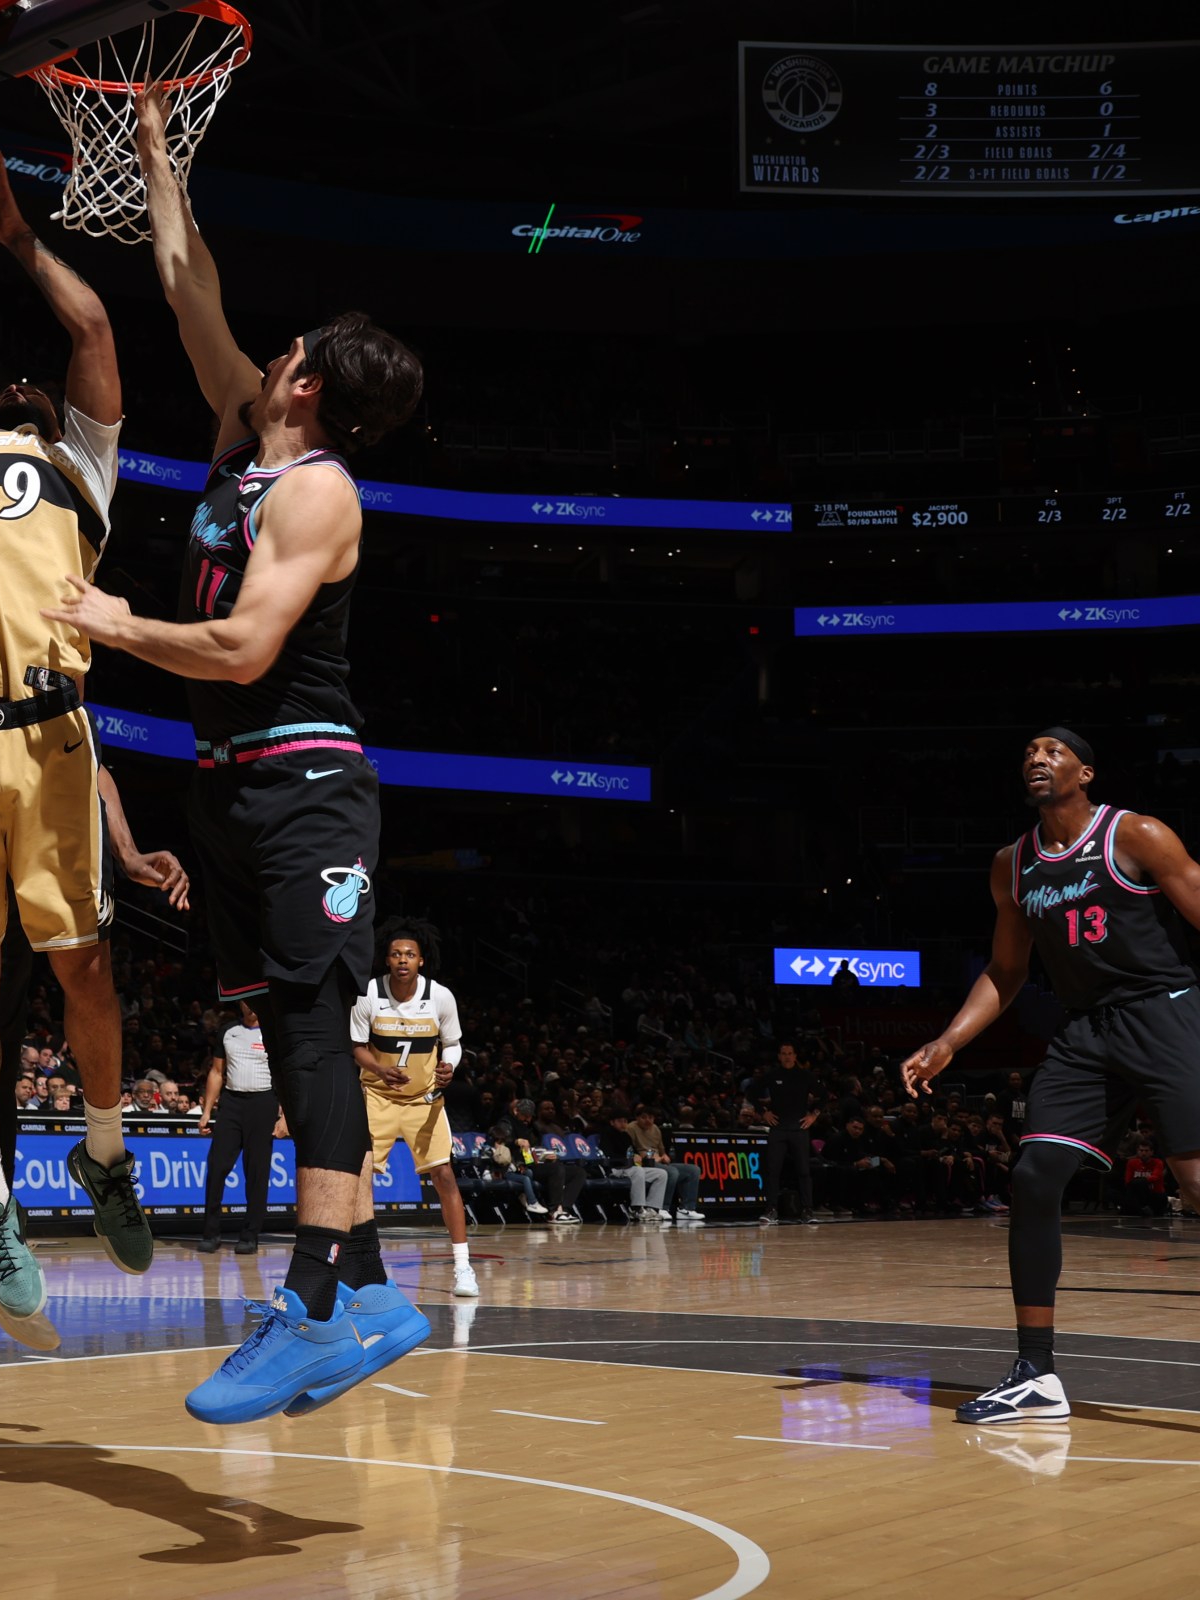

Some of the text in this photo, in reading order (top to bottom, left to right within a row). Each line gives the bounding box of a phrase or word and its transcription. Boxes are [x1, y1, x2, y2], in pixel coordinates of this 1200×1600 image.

[770, 57, 833, 79] WASHINGTON
[923, 54, 1116, 73] GAME MATCHUP
[924, 80, 1113, 96] 8 POINTS 6
[925, 102, 1114, 117] 3 REBOUNDS 0
[779, 113, 827, 128] WIZARDS
[925, 123, 1112, 138] 2 ASSISTS 1
[752, 154, 806, 165] WASHINGTON
[913, 144, 1127, 159] 2/3 FIELD GOALS 2/4
[753, 165, 820, 183] WIZARDS
[914, 164, 1127, 180] 2/2 3-PT FIELD GOALS 1/2
[137, 459, 182, 481] ZKsync
[359, 487, 393, 505] Ksync
[1044, 499, 1057, 507] FG
[1106, 496, 1123, 505] 3PT
[1173, 491, 1186, 500] FT
[555, 502, 606, 520] ZKsync
[814, 503, 848, 512] 2:18 PM
[847, 509, 897, 517] FOUNDATION
[927, 504, 959, 512] JACKPOT
[1102, 508, 1128, 521] 2/2
[1164, 503, 1192, 517] 2/2
[847, 518, 899, 526] 50/50 RAFFLE
[911, 511, 969, 528] $2,900
[1037, 510, 1063, 523] 2/3
[195, 558, 230, 619] 11
[842, 612, 895, 630] ZKsync
[1084, 606, 1140, 624] ZKsync
[104, 716, 149, 743] ZKsync
[576, 769, 630, 792] ZKsync
[1020, 870, 1101, 918] Miami
[1064, 904, 1108, 948] 13
[396, 1040, 413, 1068] 7
[12, 1149, 295, 1200] Coupg Drivs .S.
